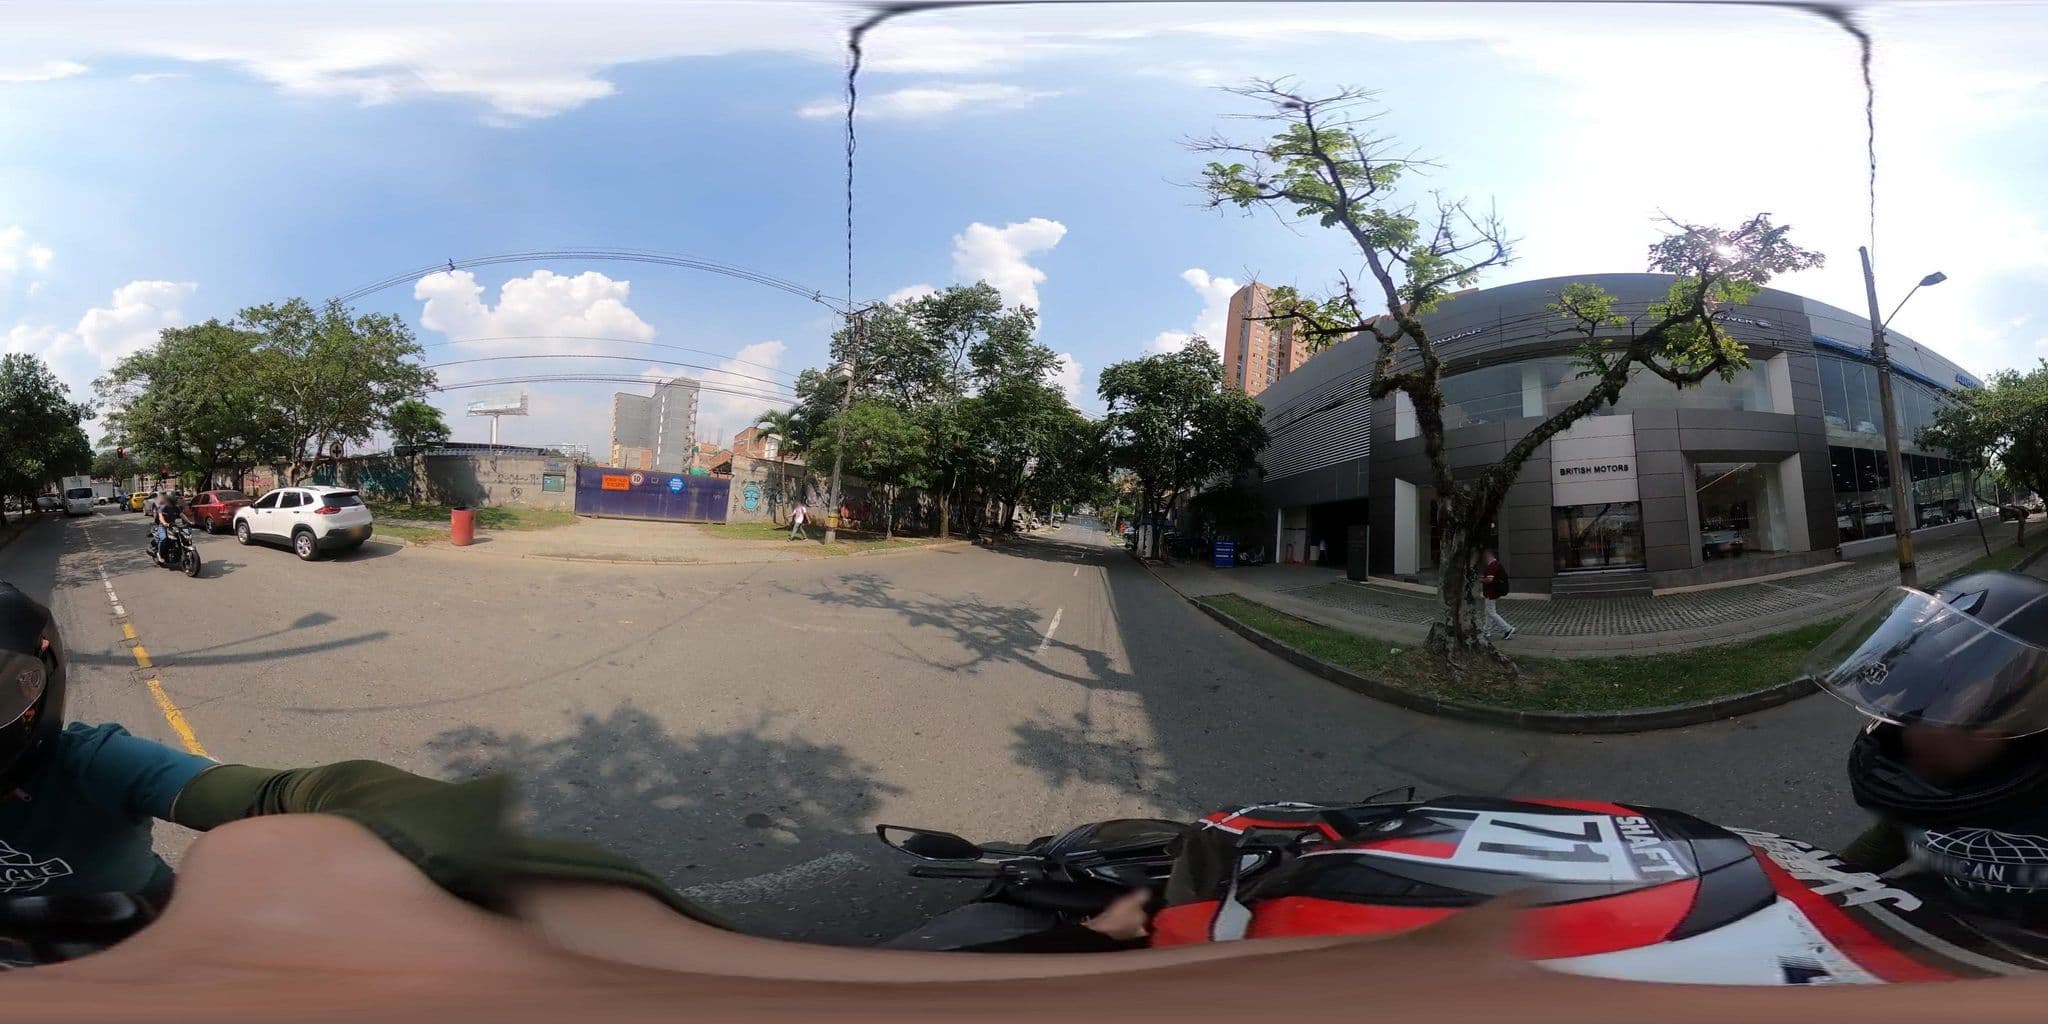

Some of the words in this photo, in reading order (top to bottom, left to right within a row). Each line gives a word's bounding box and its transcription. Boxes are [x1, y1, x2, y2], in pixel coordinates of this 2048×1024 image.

[1560, 466, 1592, 476] BRITISH
[1594, 464, 1629, 473] MOTORS
[1478, 819, 1609, 862] 71
[1615, 816, 1687, 876] SHAFT
